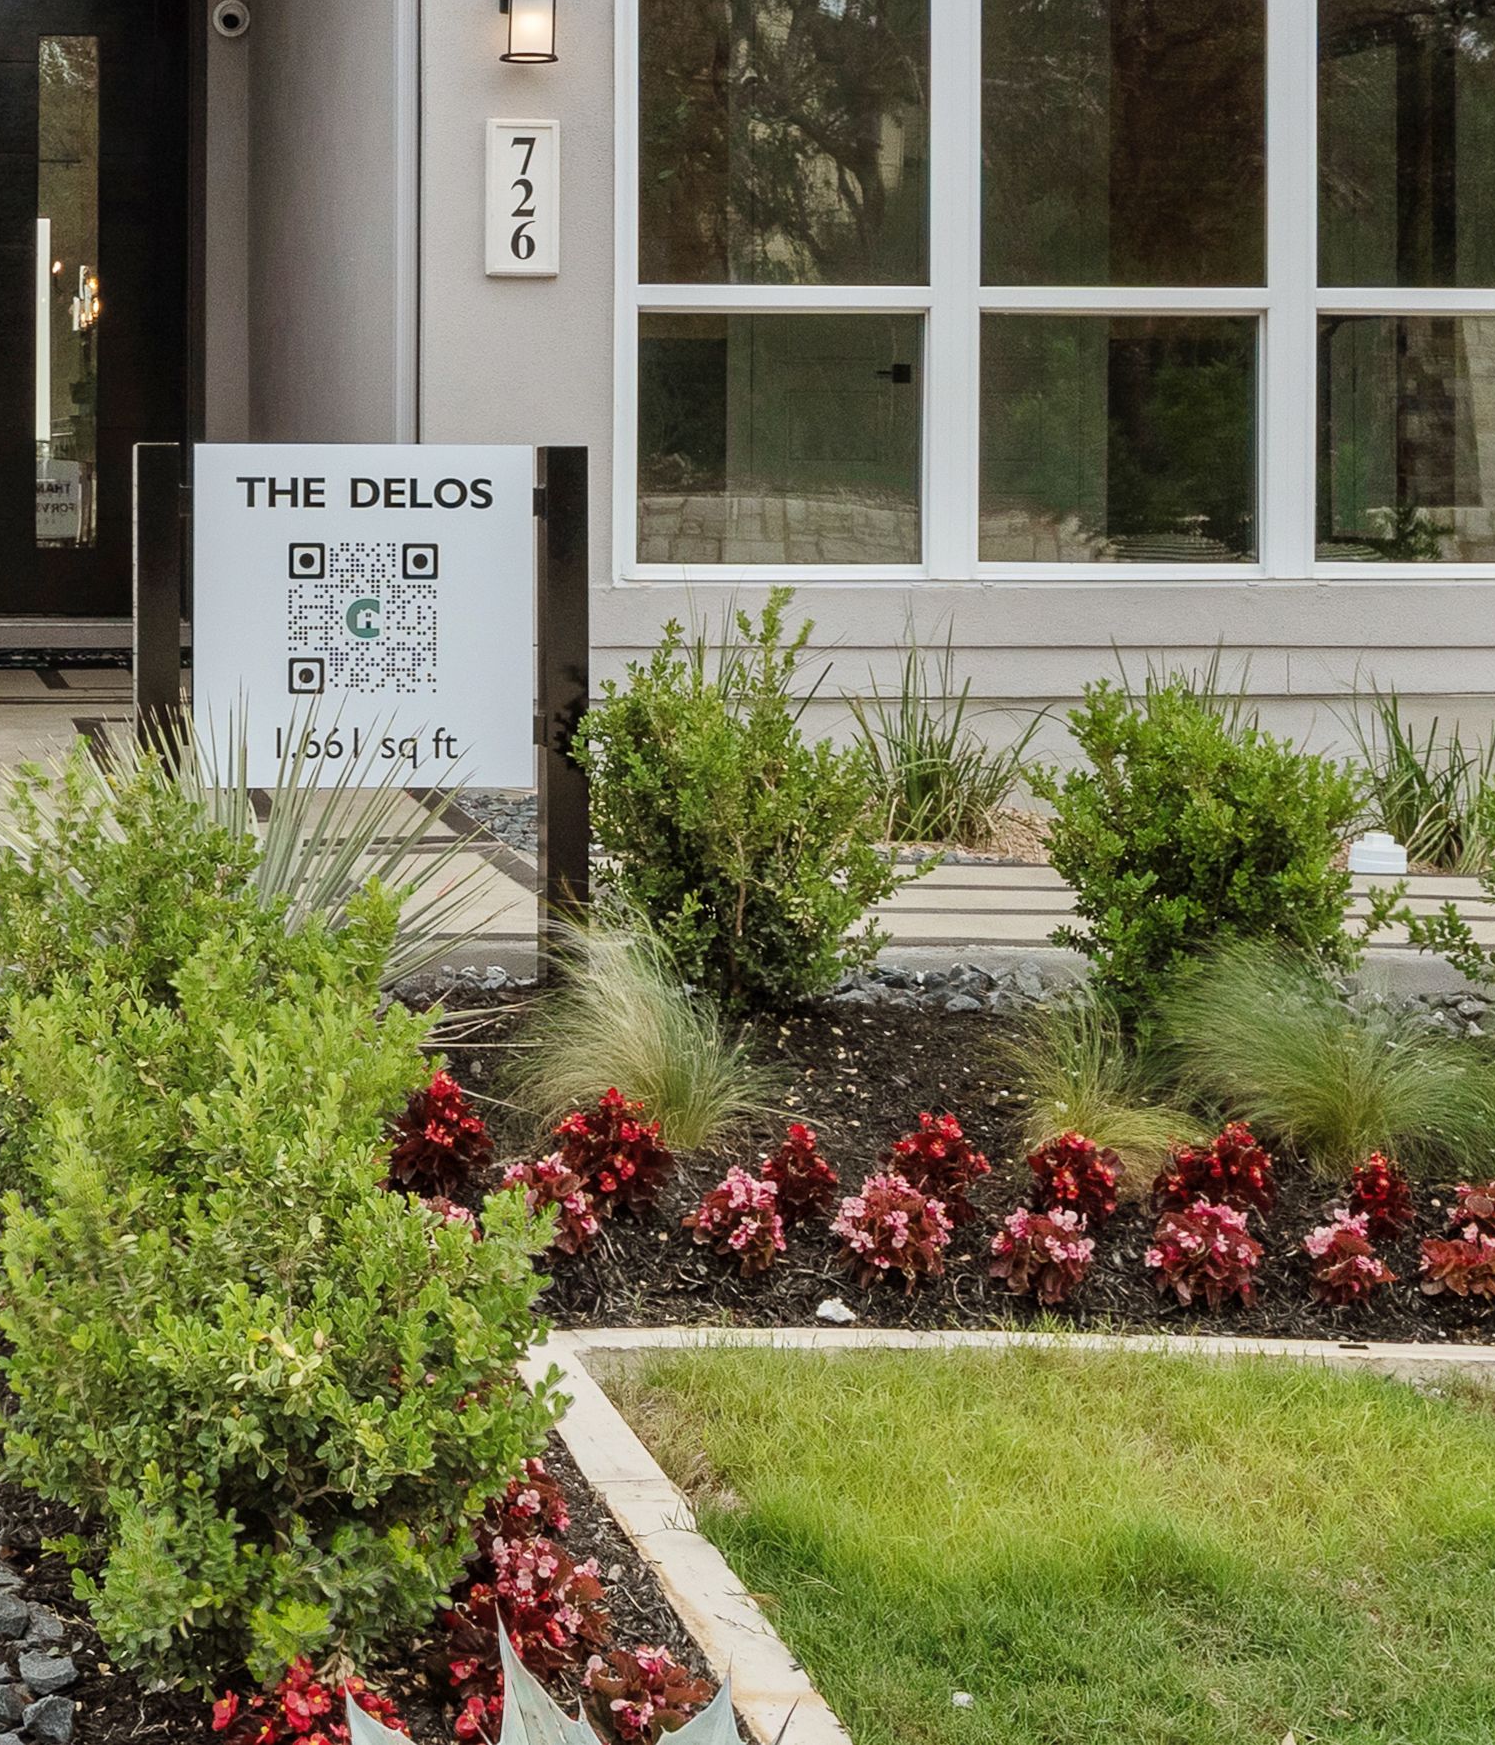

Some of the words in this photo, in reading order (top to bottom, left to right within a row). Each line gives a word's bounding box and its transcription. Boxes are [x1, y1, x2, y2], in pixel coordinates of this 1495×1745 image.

[510, 137, 537, 260] 726
[236, 477, 326, 508] THE
[350, 478, 494, 509] DELOS
[380, 737, 418, 769] sq
[432, 727, 459, 759] ft
